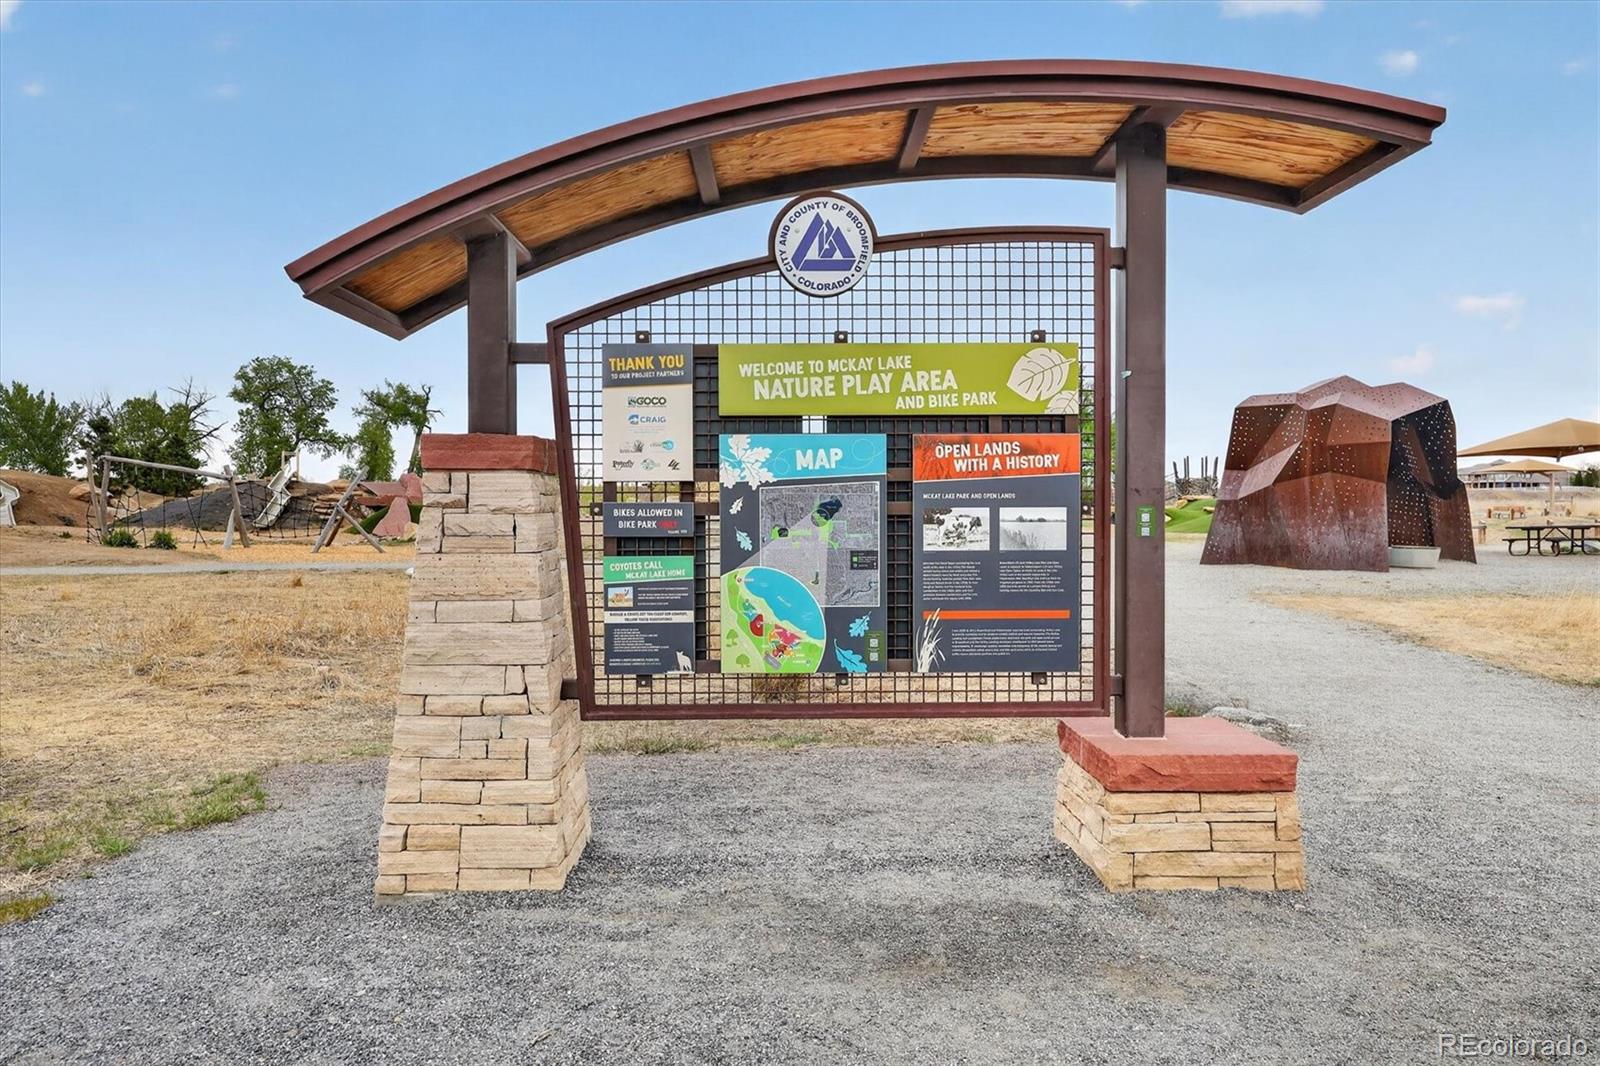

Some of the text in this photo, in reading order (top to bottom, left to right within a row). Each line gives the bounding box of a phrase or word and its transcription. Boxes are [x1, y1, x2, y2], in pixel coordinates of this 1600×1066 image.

[779, 201, 869, 272] CITY AND COUNTY OF BROOMFIELD
[798, 276, 852, 291] COLORADO
[608, 354, 685, 372] THANK YOU
[738, 355, 912, 378] WELCOME TO MCKAY LAKE
[753, 369, 958, 400] NATURE PLAY AREA
[636, 396, 667, 406] GOCO
[895, 391, 998, 410] AND BIKE PARK
[935, 441, 1021, 459] OPEN LANDS
[796, 447, 844, 472] MAP
[953, 454, 1060, 472] WITH A HISTORY
[613, 508, 683, 517] BIKES ALLOWED IN
[618, 520, 636, 528] BIKE
[638, 520, 657, 528] PARK
[610, 560, 663, 572] COYOTES CALL
[650, 570, 666, 578] LAKE
[667, 569, 686, 577] HOME
